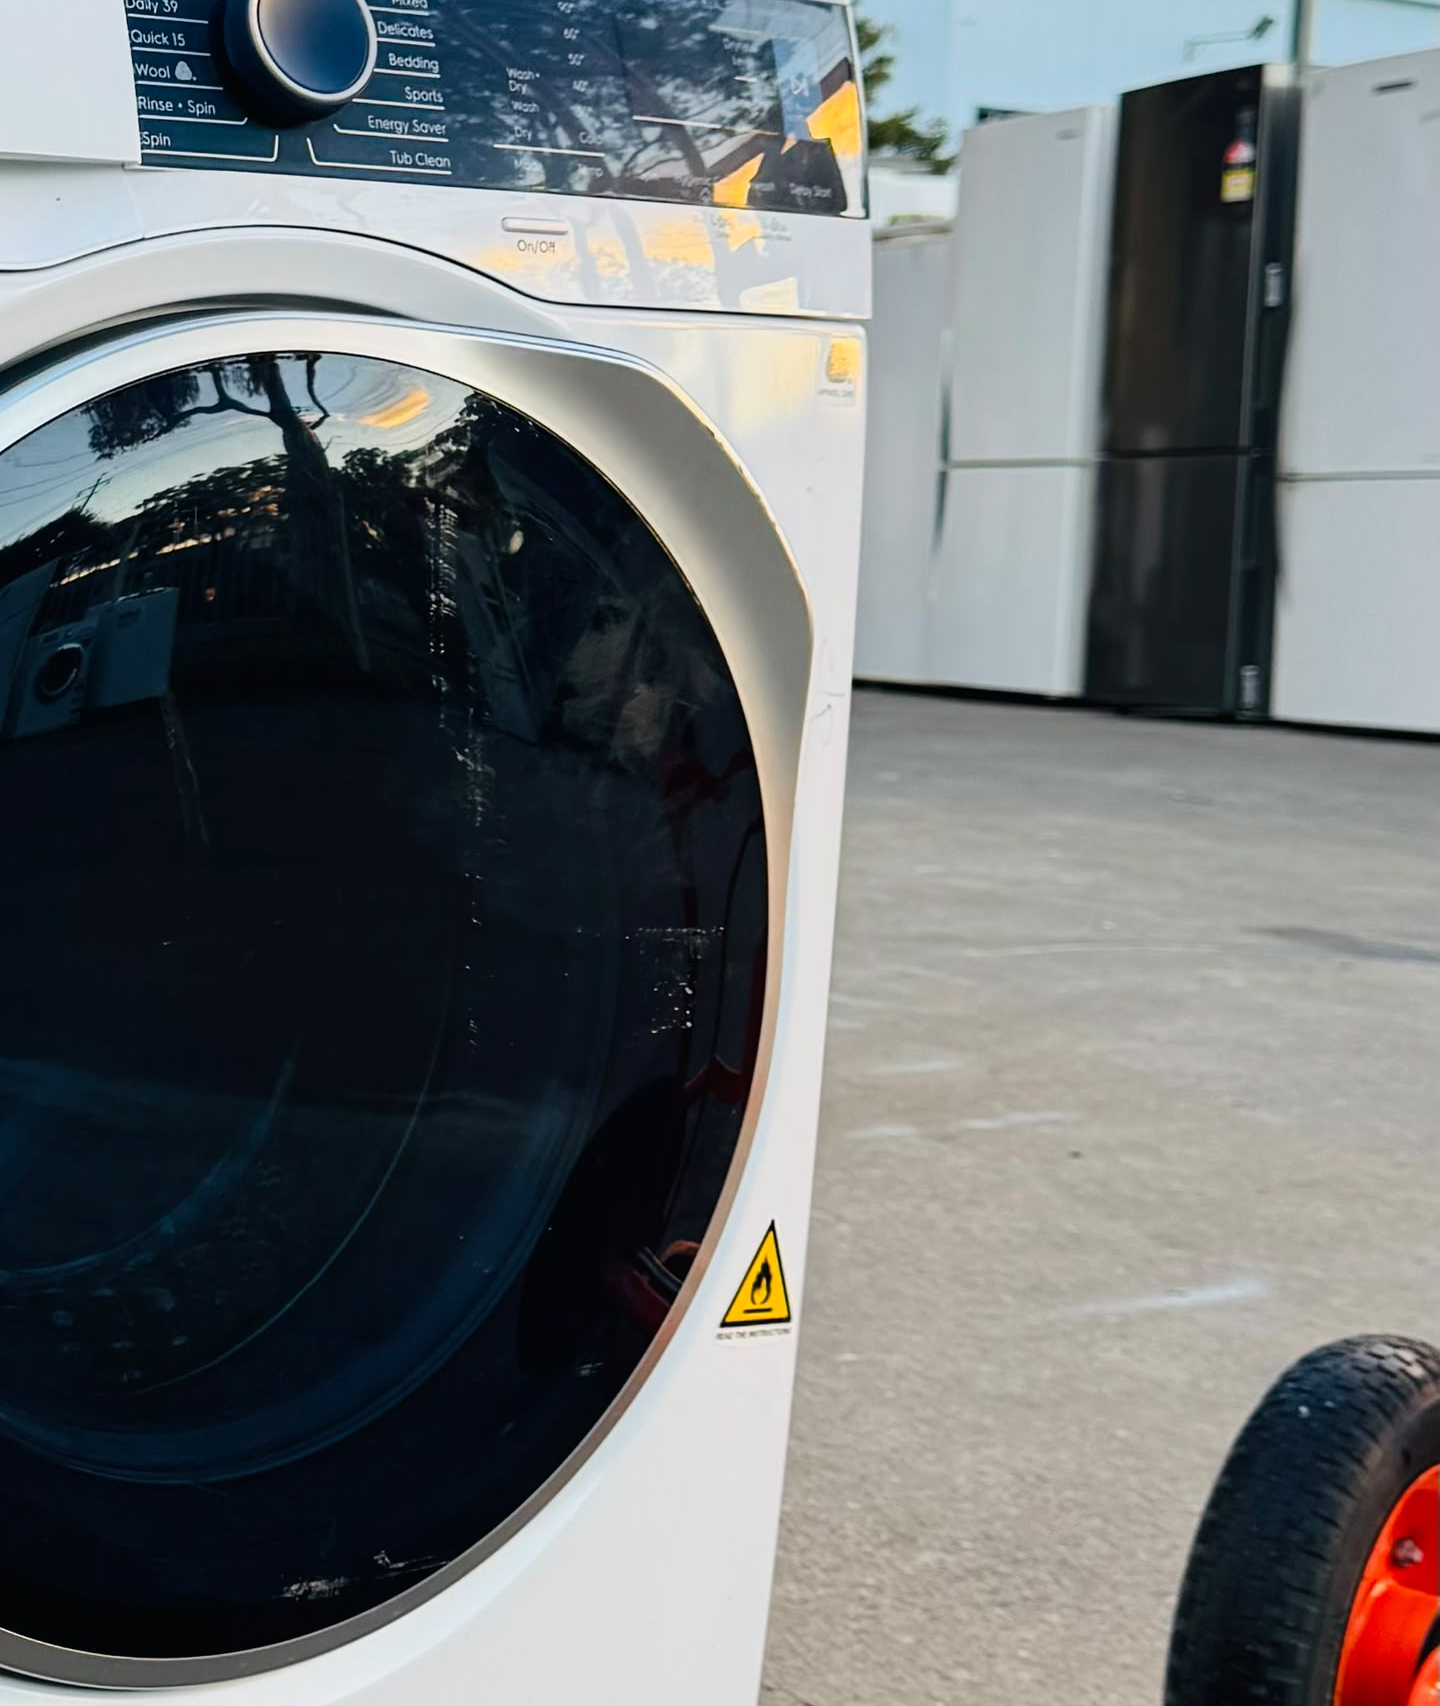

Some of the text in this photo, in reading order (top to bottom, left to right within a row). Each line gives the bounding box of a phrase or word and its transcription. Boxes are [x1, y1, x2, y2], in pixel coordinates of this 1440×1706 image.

[163, 0, 178, 13] 39
[131, 29, 185, 47] Quick 15
[377, 21, 434, 39] Delicates
[135, 63, 171, 78] Wool
[388, 53, 439, 73] Bedding
[404, 86, 443, 103] Sports
[508, 80, 527, 94] Dry
[138, 96, 215, 117] Rinse Spin
[512, 101, 539, 112] Wash
[368, 115, 446, 134] Energy Saver
[142, 131, 171, 147] Spin
[514, 126, 532, 141] Dry
[389, 150, 451, 167] Tub Clean
[517, 240, 557, 254] On/Off
